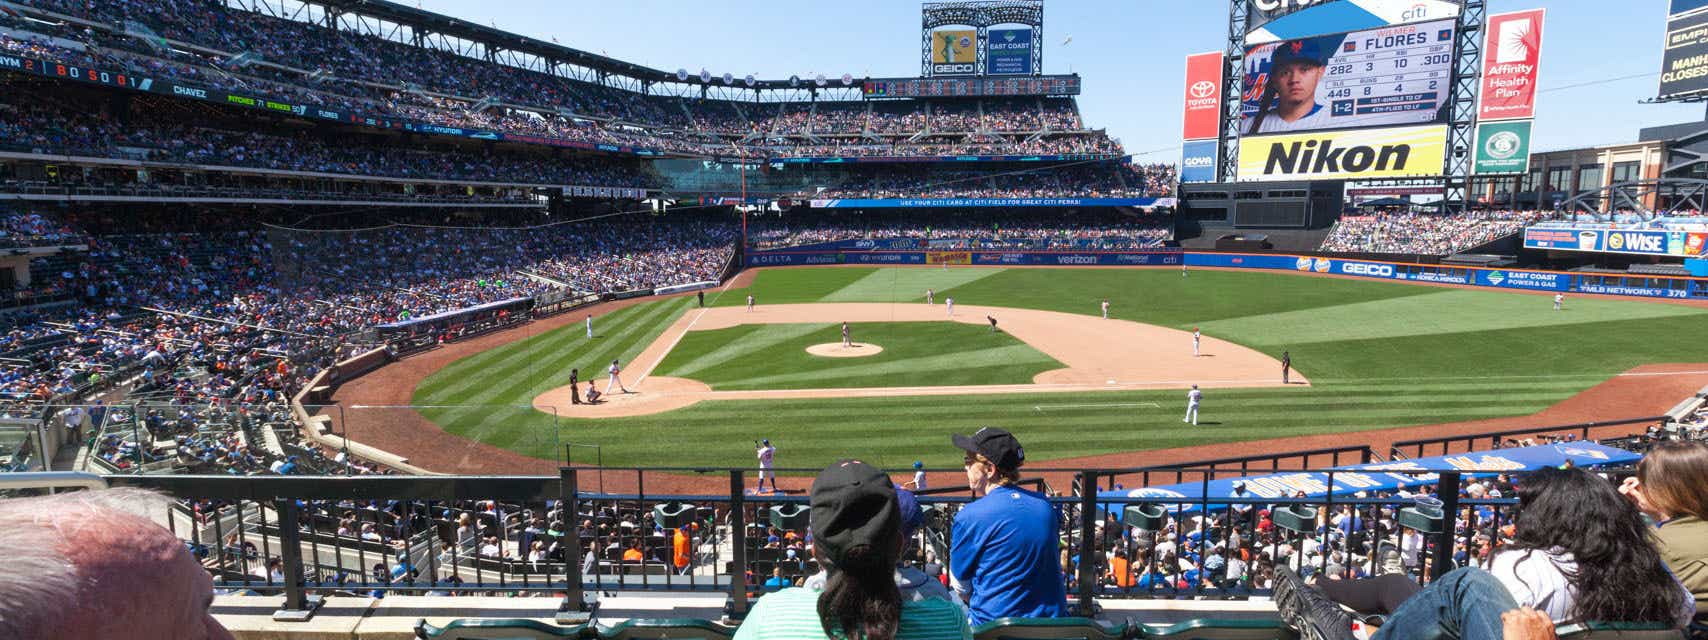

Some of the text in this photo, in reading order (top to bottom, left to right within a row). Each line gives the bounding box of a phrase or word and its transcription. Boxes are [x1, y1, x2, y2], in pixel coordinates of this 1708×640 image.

[1401, 4, 1426, 21] citi
[1365, 32, 1427, 50] FLORES
[935, 64, 973, 73] GEICO
[1327, 54, 1450, 76] .282 3 10 .300
[1488, 64, 1533, 76] Affinity
[1662, 65, 1708, 82] CLOSES
[130, 77, 135, 87] 1
[1489, 77, 1528, 88] Health
[173, 85, 206, 98] CHAVEZ
[1363, 87, 1371, 95] 8
[1395, 84, 1403, 92] 4
[1428, 80, 1437, 89] 2
[1495, 88, 1520, 98] Plan
[1188, 97, 1217, 106] TOYOTA
[1334, 103, 1351, 112] 1-2
[434, 127, 462, 135] HYUNDAI
[1264, 139, 1411, 175] Nikon
[1625, 233, 1664, 252] WISE
[1058, 254, 1097, 264] verizon
[1163, 256, 1177, 264] citi
[1342, 263, 1392, 276] GEICO
[1508, 271, 1557, 281] EAST COAST
[1508, 279, 1533, 287] POWER
[1607, 286, 1653, 296] NETWORK
